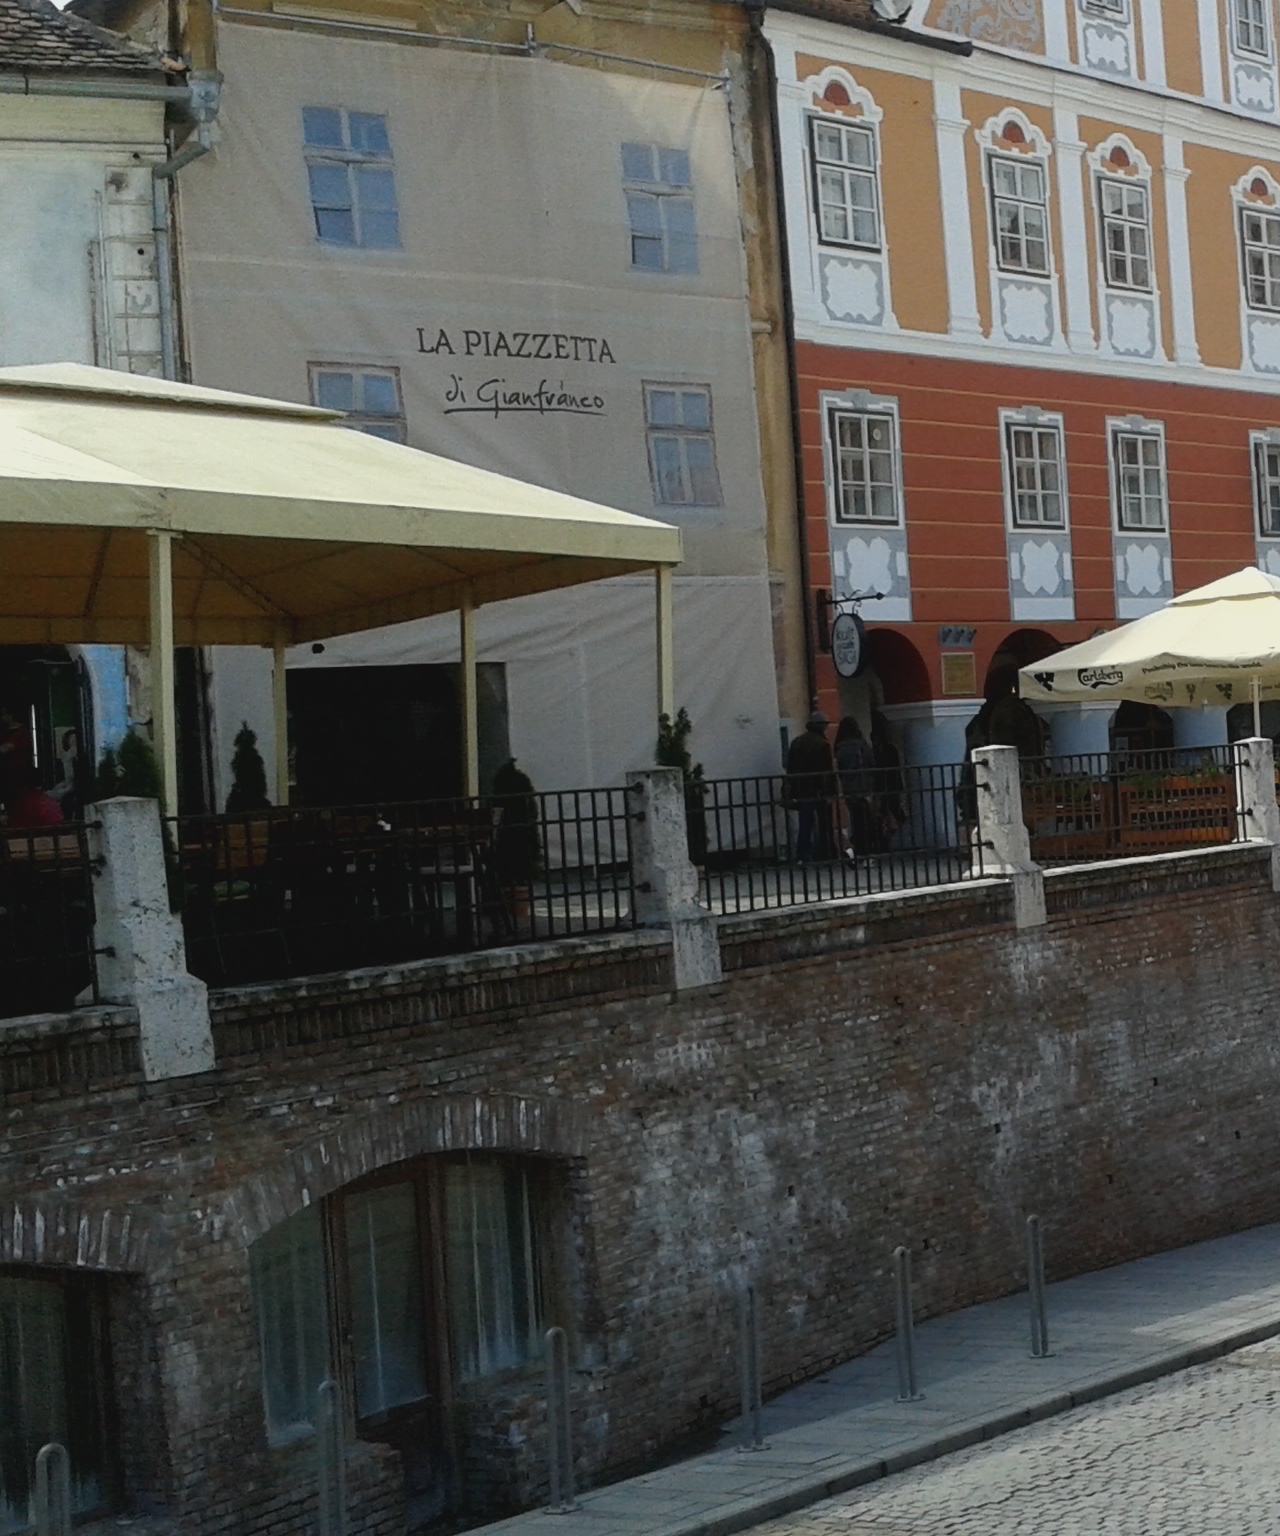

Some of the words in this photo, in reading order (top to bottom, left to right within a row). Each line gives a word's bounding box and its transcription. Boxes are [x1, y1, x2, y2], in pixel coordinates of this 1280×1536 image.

[416, 328, 456, 355] LA
[463, 330, 616, 363] PIAZZETTA
[446, 374, 466, 403] di
[1078, 666, 1124, 689] Carlsberg
